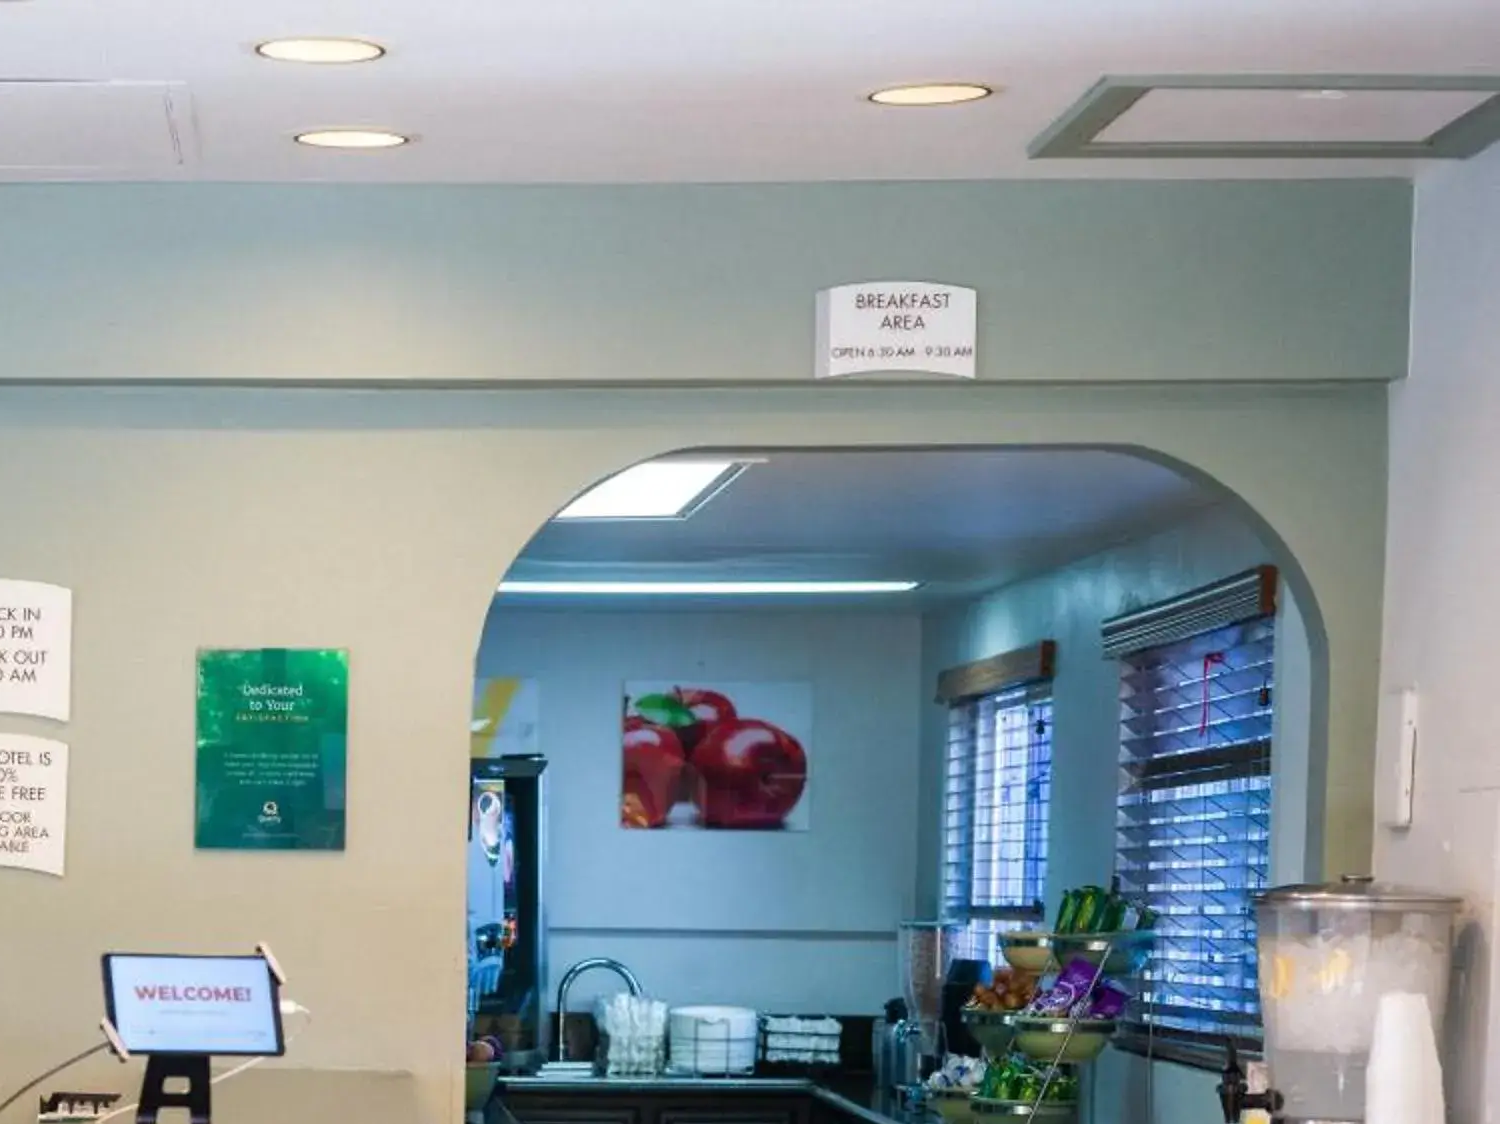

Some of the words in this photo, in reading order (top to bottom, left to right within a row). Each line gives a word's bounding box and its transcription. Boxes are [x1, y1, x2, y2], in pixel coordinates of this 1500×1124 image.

[855, 293, 951, 310] BREAKFAST
[879, 315, 925, 330] AREA
[831, 346, 865, 359] OPEN
[867, 347, 894, 358] 630
[896, 347, 915, 357] AM
[925, 346, 951, 357] 930
[953, 346, 973, 357] AM
[23, 607, 41, 621] IN
[11, 625, 34, 640] PM
[13, 649, 48, 665] OUT
[9, 668, 37, 682] AM
[243, 682, 303, 697] Dedicated
[249, 700, 262, 711] to
[266, 699, 295, 711] Your
[39, 751, 52, 766] IS
[11, 786, 46, 801] FREE
[13, 825, 49, 840] AREA
[134, 985, 252, 1003] WELCOME!
